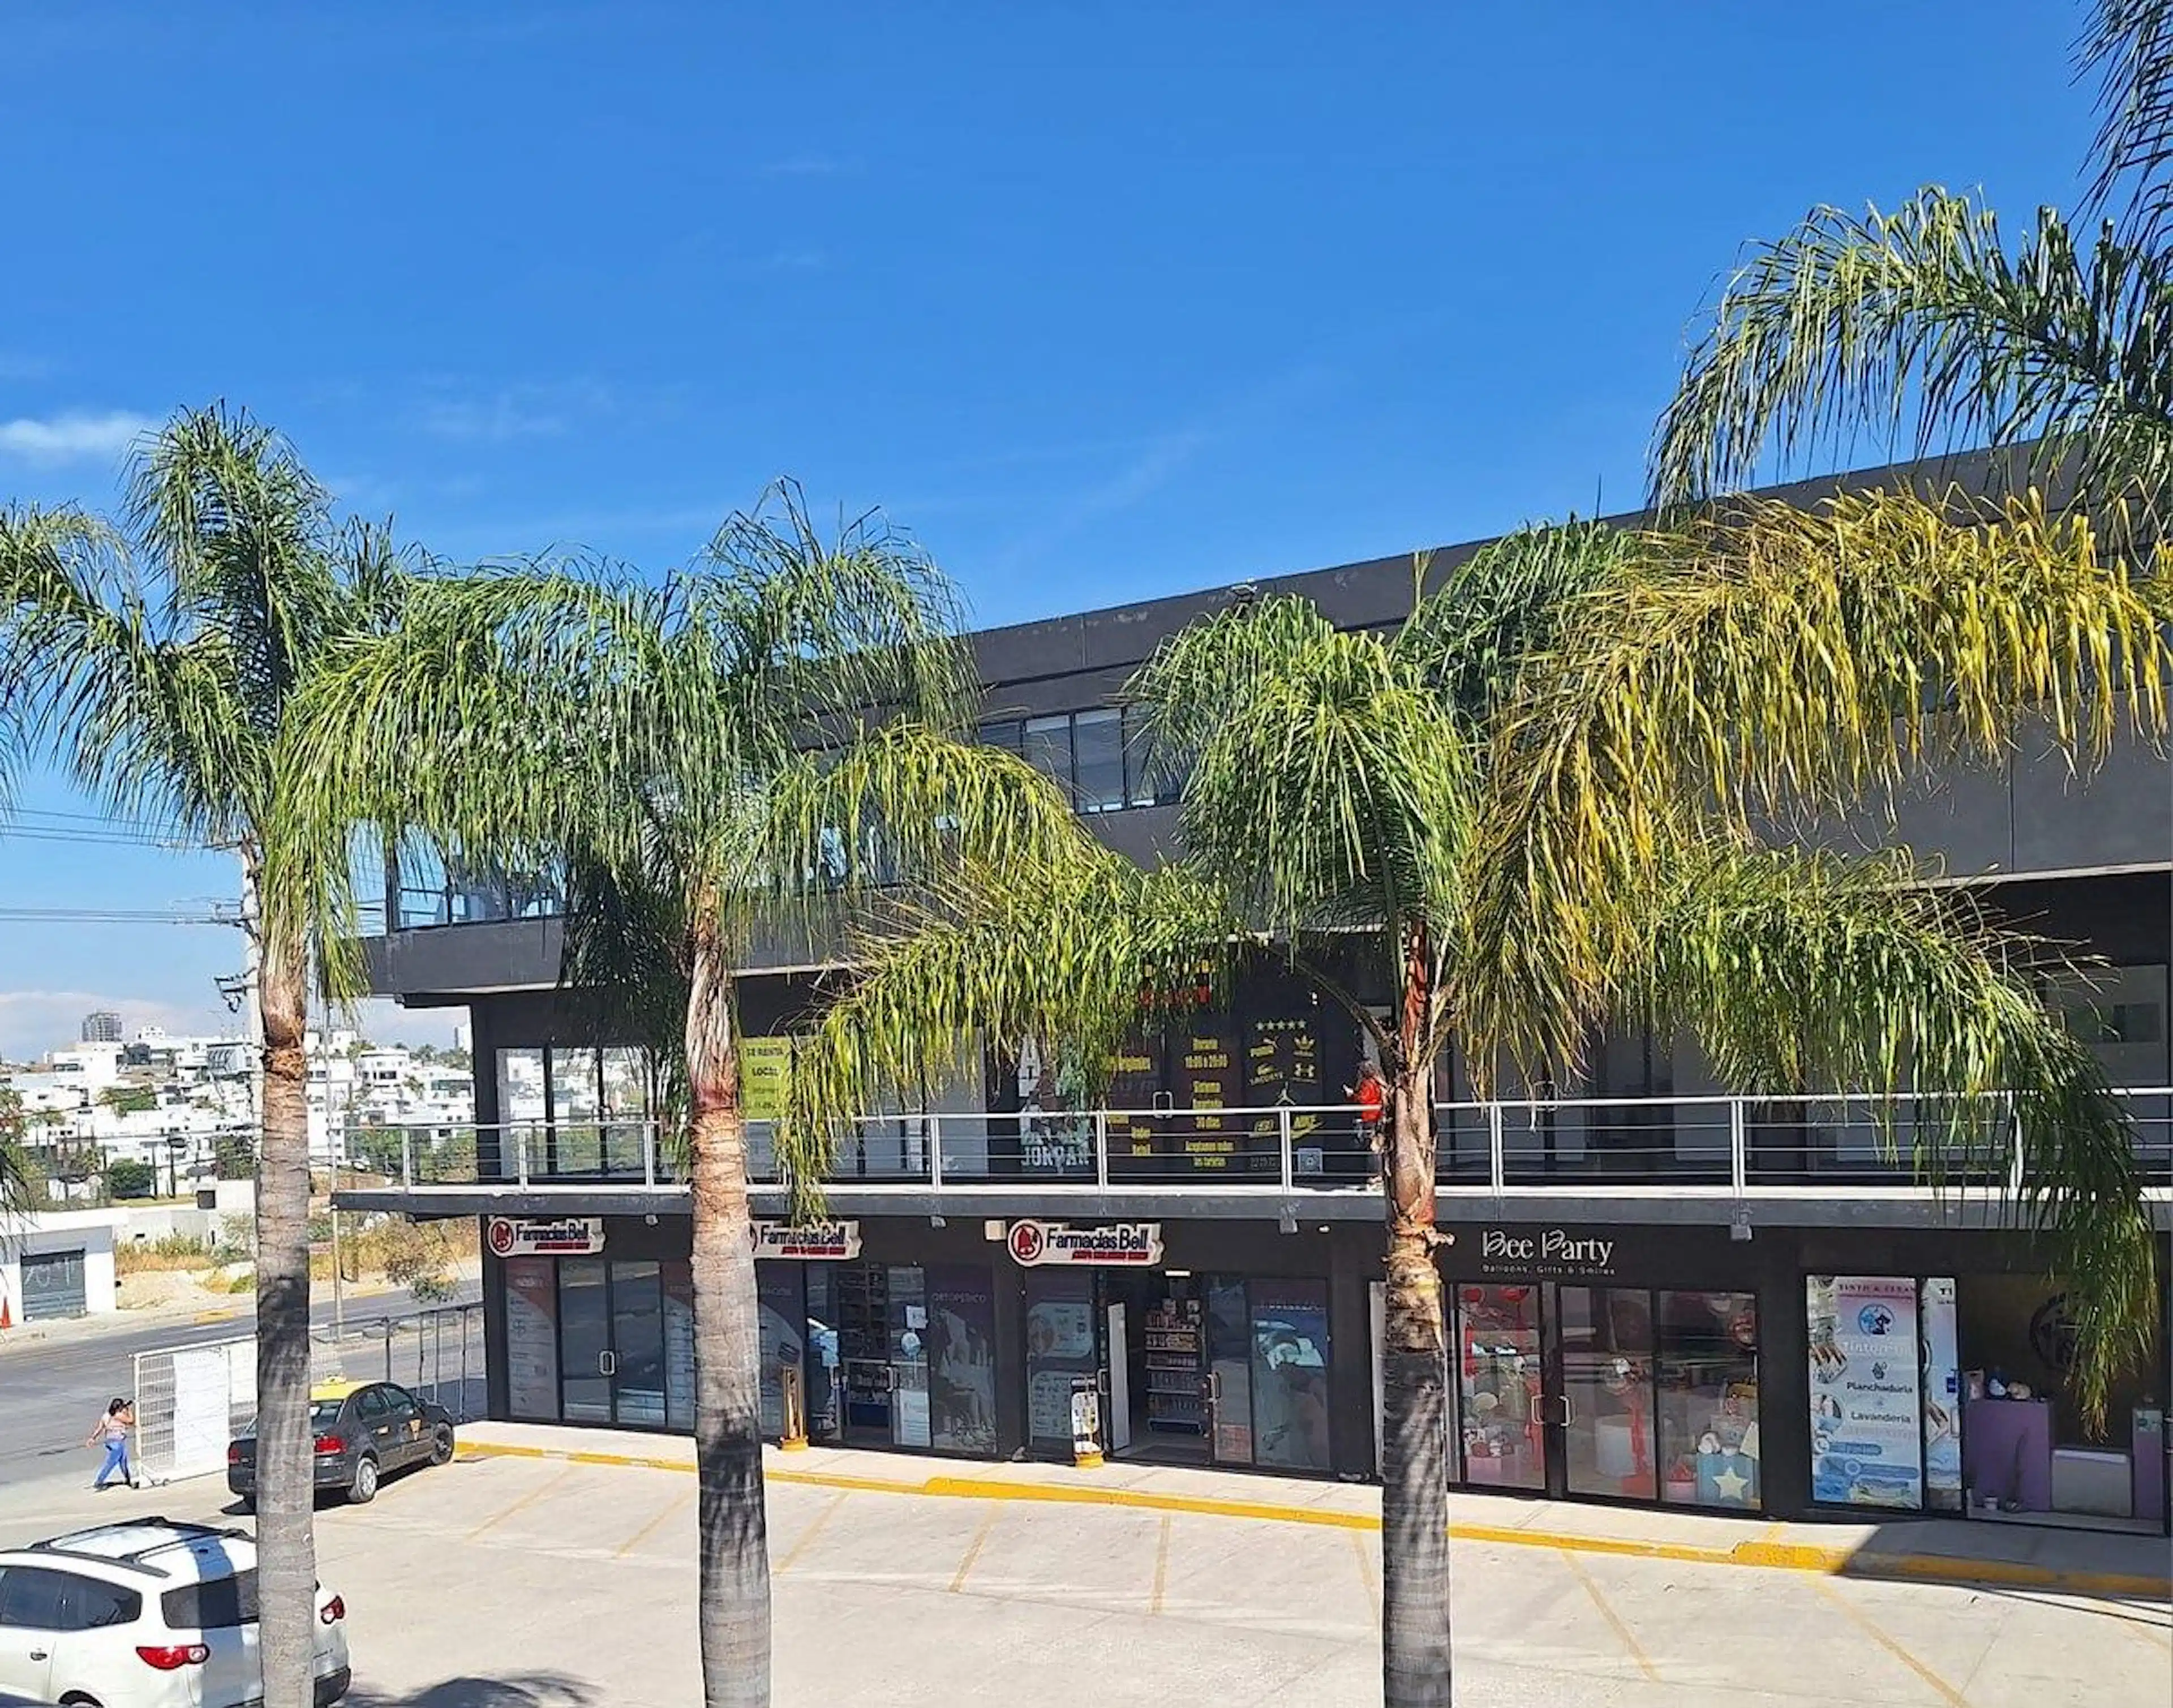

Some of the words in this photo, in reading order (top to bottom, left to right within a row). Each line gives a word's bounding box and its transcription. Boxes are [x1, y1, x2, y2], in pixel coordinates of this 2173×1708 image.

[516, 1222, 568, 1241] Farmacias
[1046, 1228, 1117, 1249] Farmacias
[1119, 1229, 1147, 1250] Bell
[1481, 1230, 1535, 1260] Bee
[1541, 1229, 1613, 1267] Party
